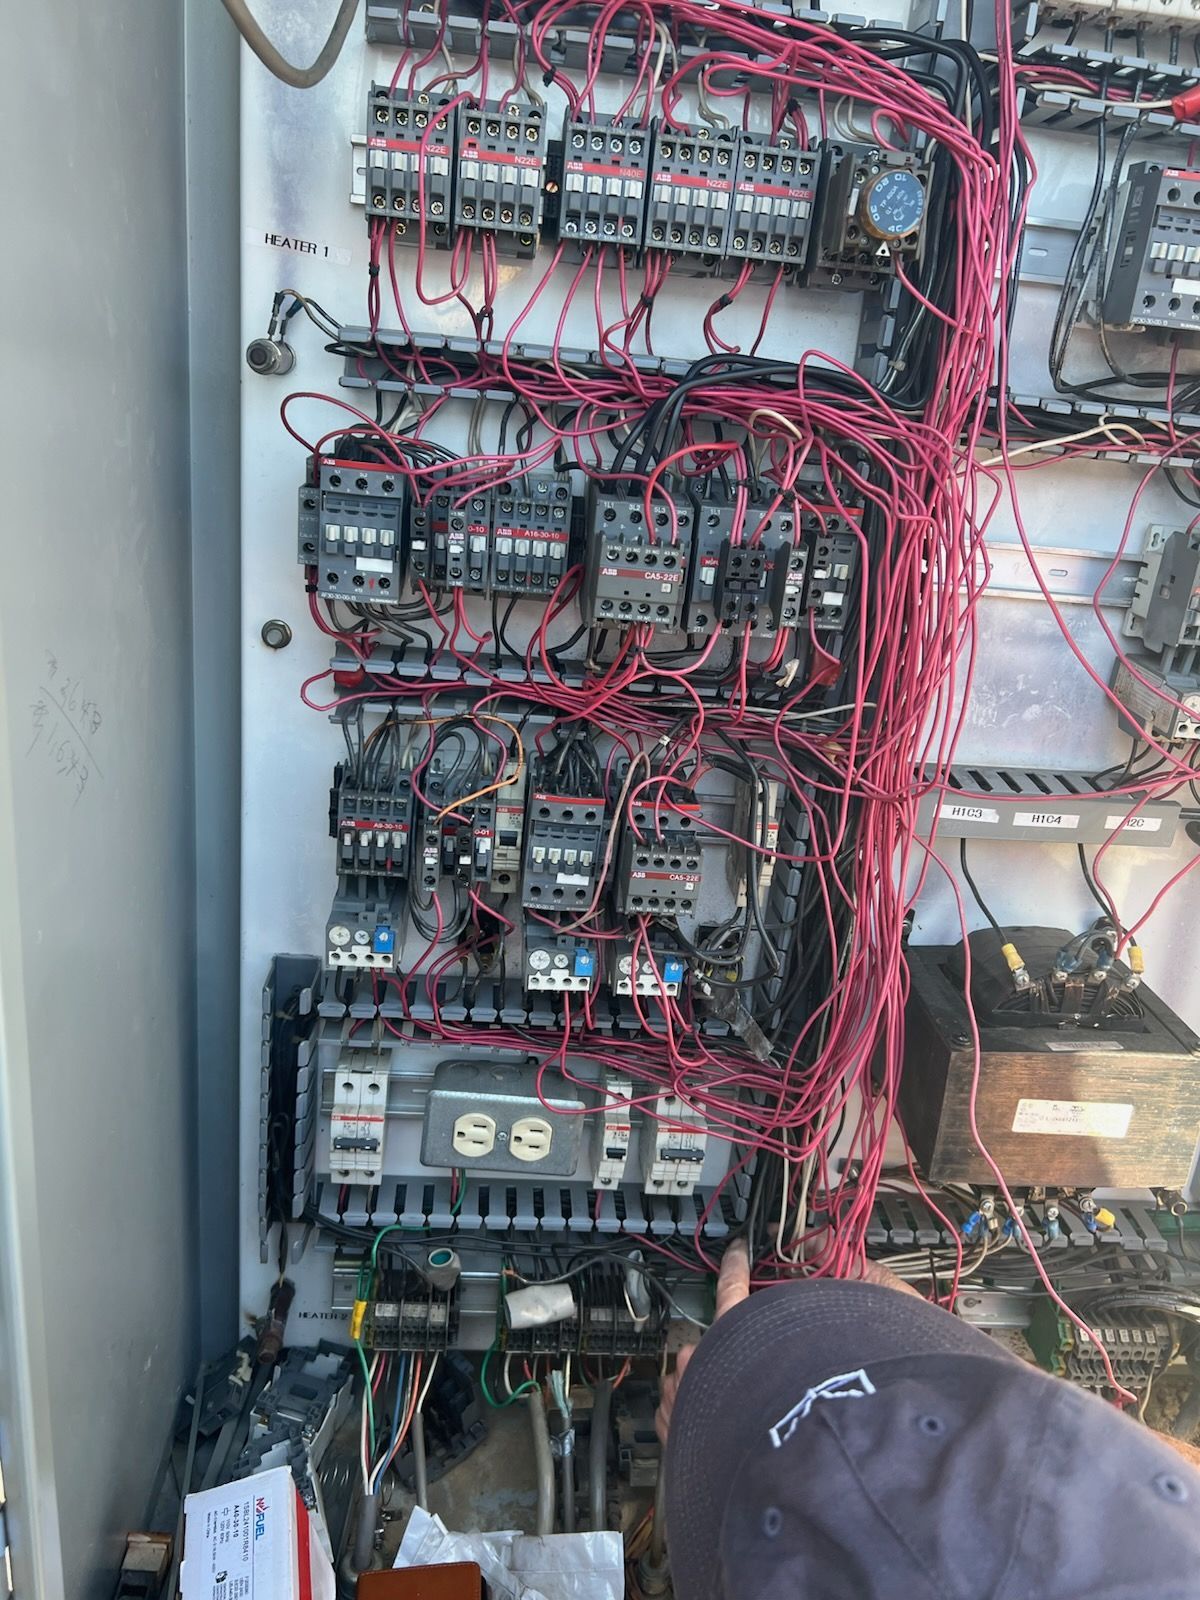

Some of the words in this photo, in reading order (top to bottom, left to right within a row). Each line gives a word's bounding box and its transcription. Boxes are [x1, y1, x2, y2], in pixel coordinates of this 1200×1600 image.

[370, 138, 386, 147] ABB
[462, 150, 478, 159] ABB
[515, 156, 537, 165] N22E
[567, 161, 583, 170] ABB
[656, 173, 672, 182] ABB
[707, 179, 728, 189] N22E
[739, 183, 754, 192] ABB
[788, 189, 810, 198] N22E
[265, 233, 317, 255] HEATER
[323, 246, 329, 258] 1
[496, 528, 512, 536] ABB
[602, 568, 618, 576] ABB
[644, 572, 680, 582] CA5-22E
[952, 807, 983, 818] H1C3
[1032, 814, 1062, 825] H1C4
[298, 1311, 338, 1320] HEATER
